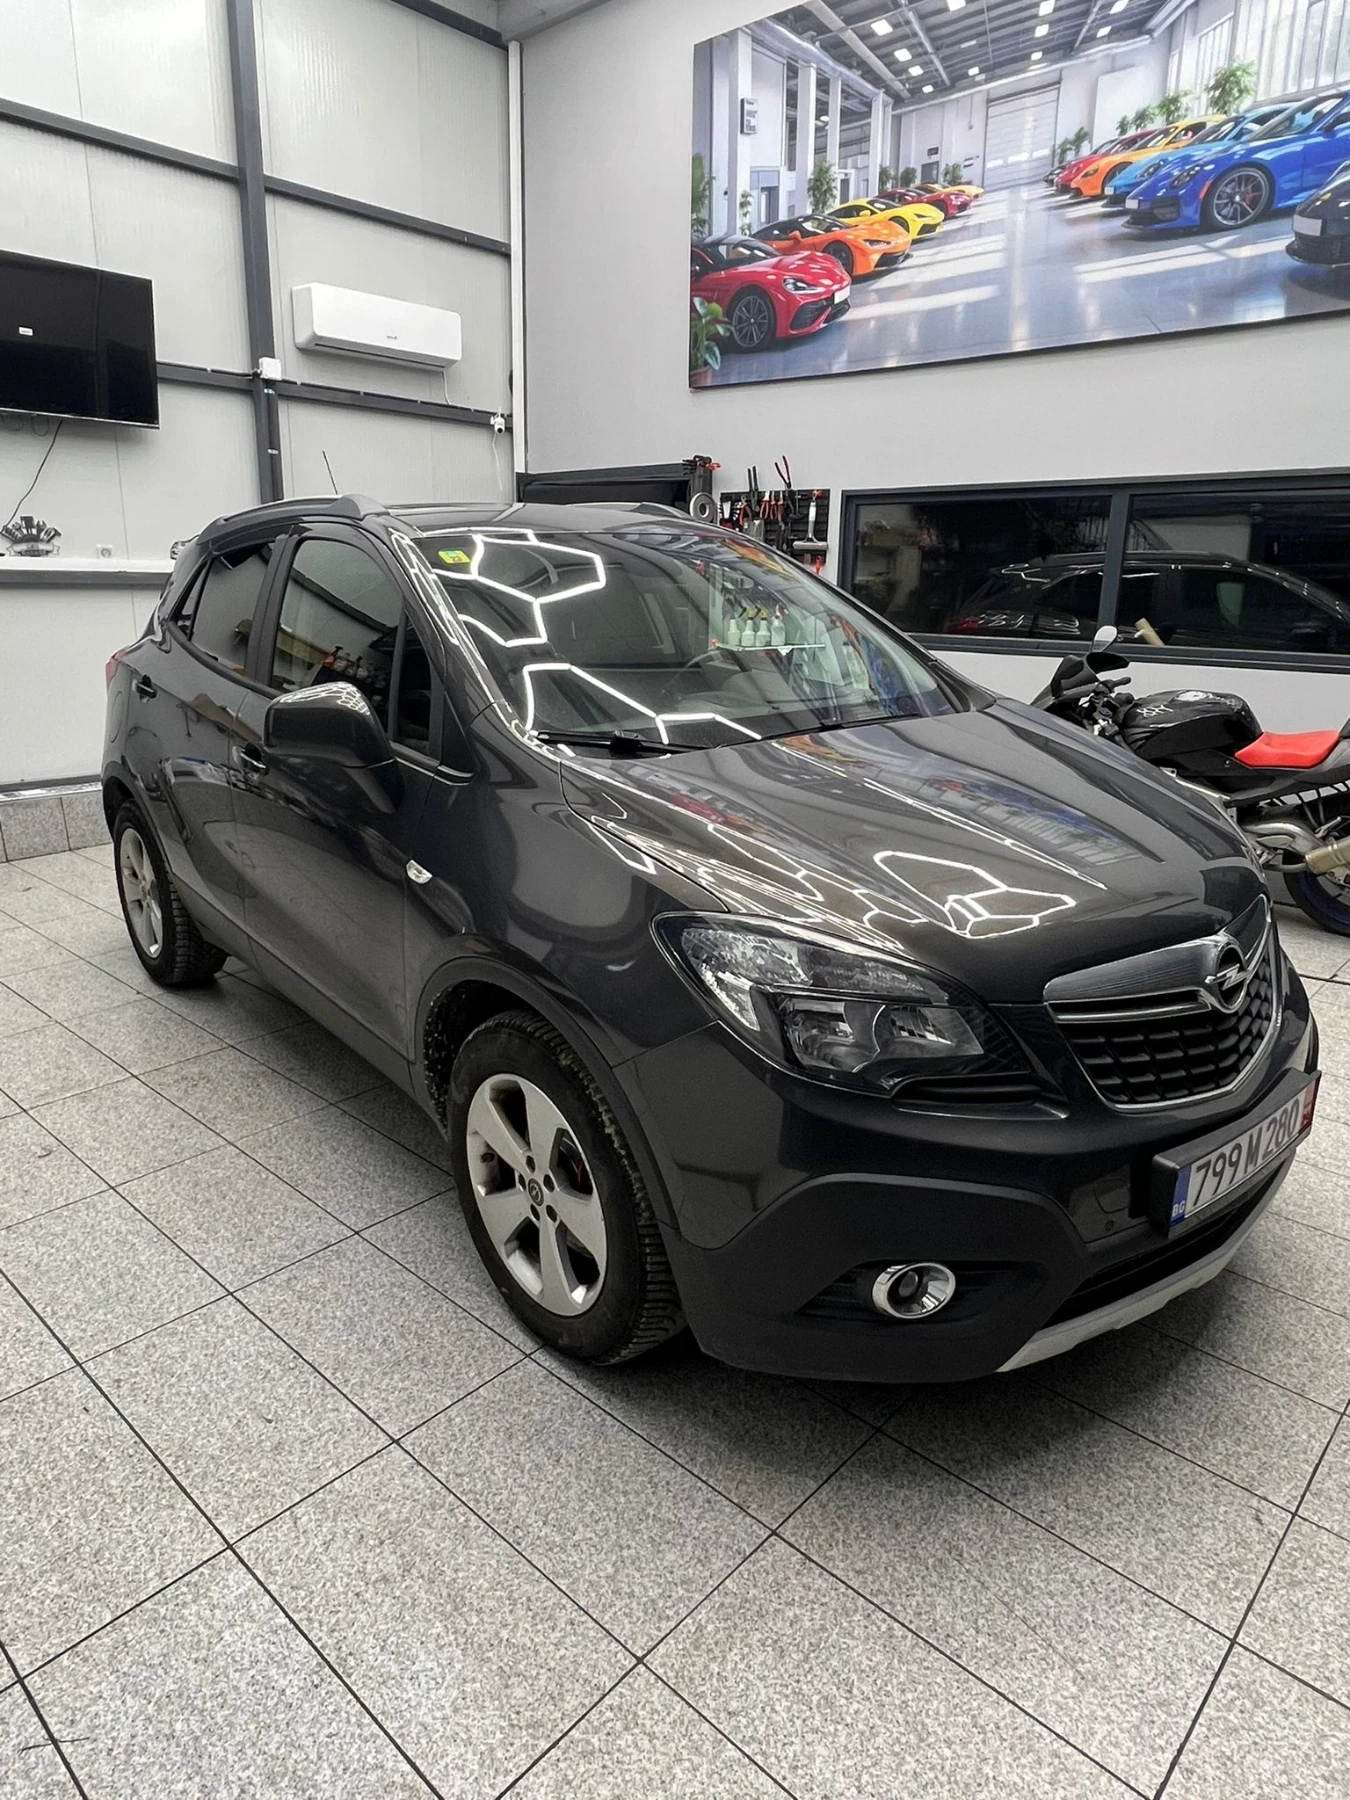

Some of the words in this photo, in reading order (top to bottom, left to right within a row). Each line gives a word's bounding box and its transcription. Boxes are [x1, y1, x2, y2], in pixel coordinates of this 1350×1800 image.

[1193, 1142, 1243, 1207] 799
[1244, 1126, 1263, 1175] M
[1262, 1098, 1300, 1161] 280
[1171, 1200, 1186, 1218] BG
